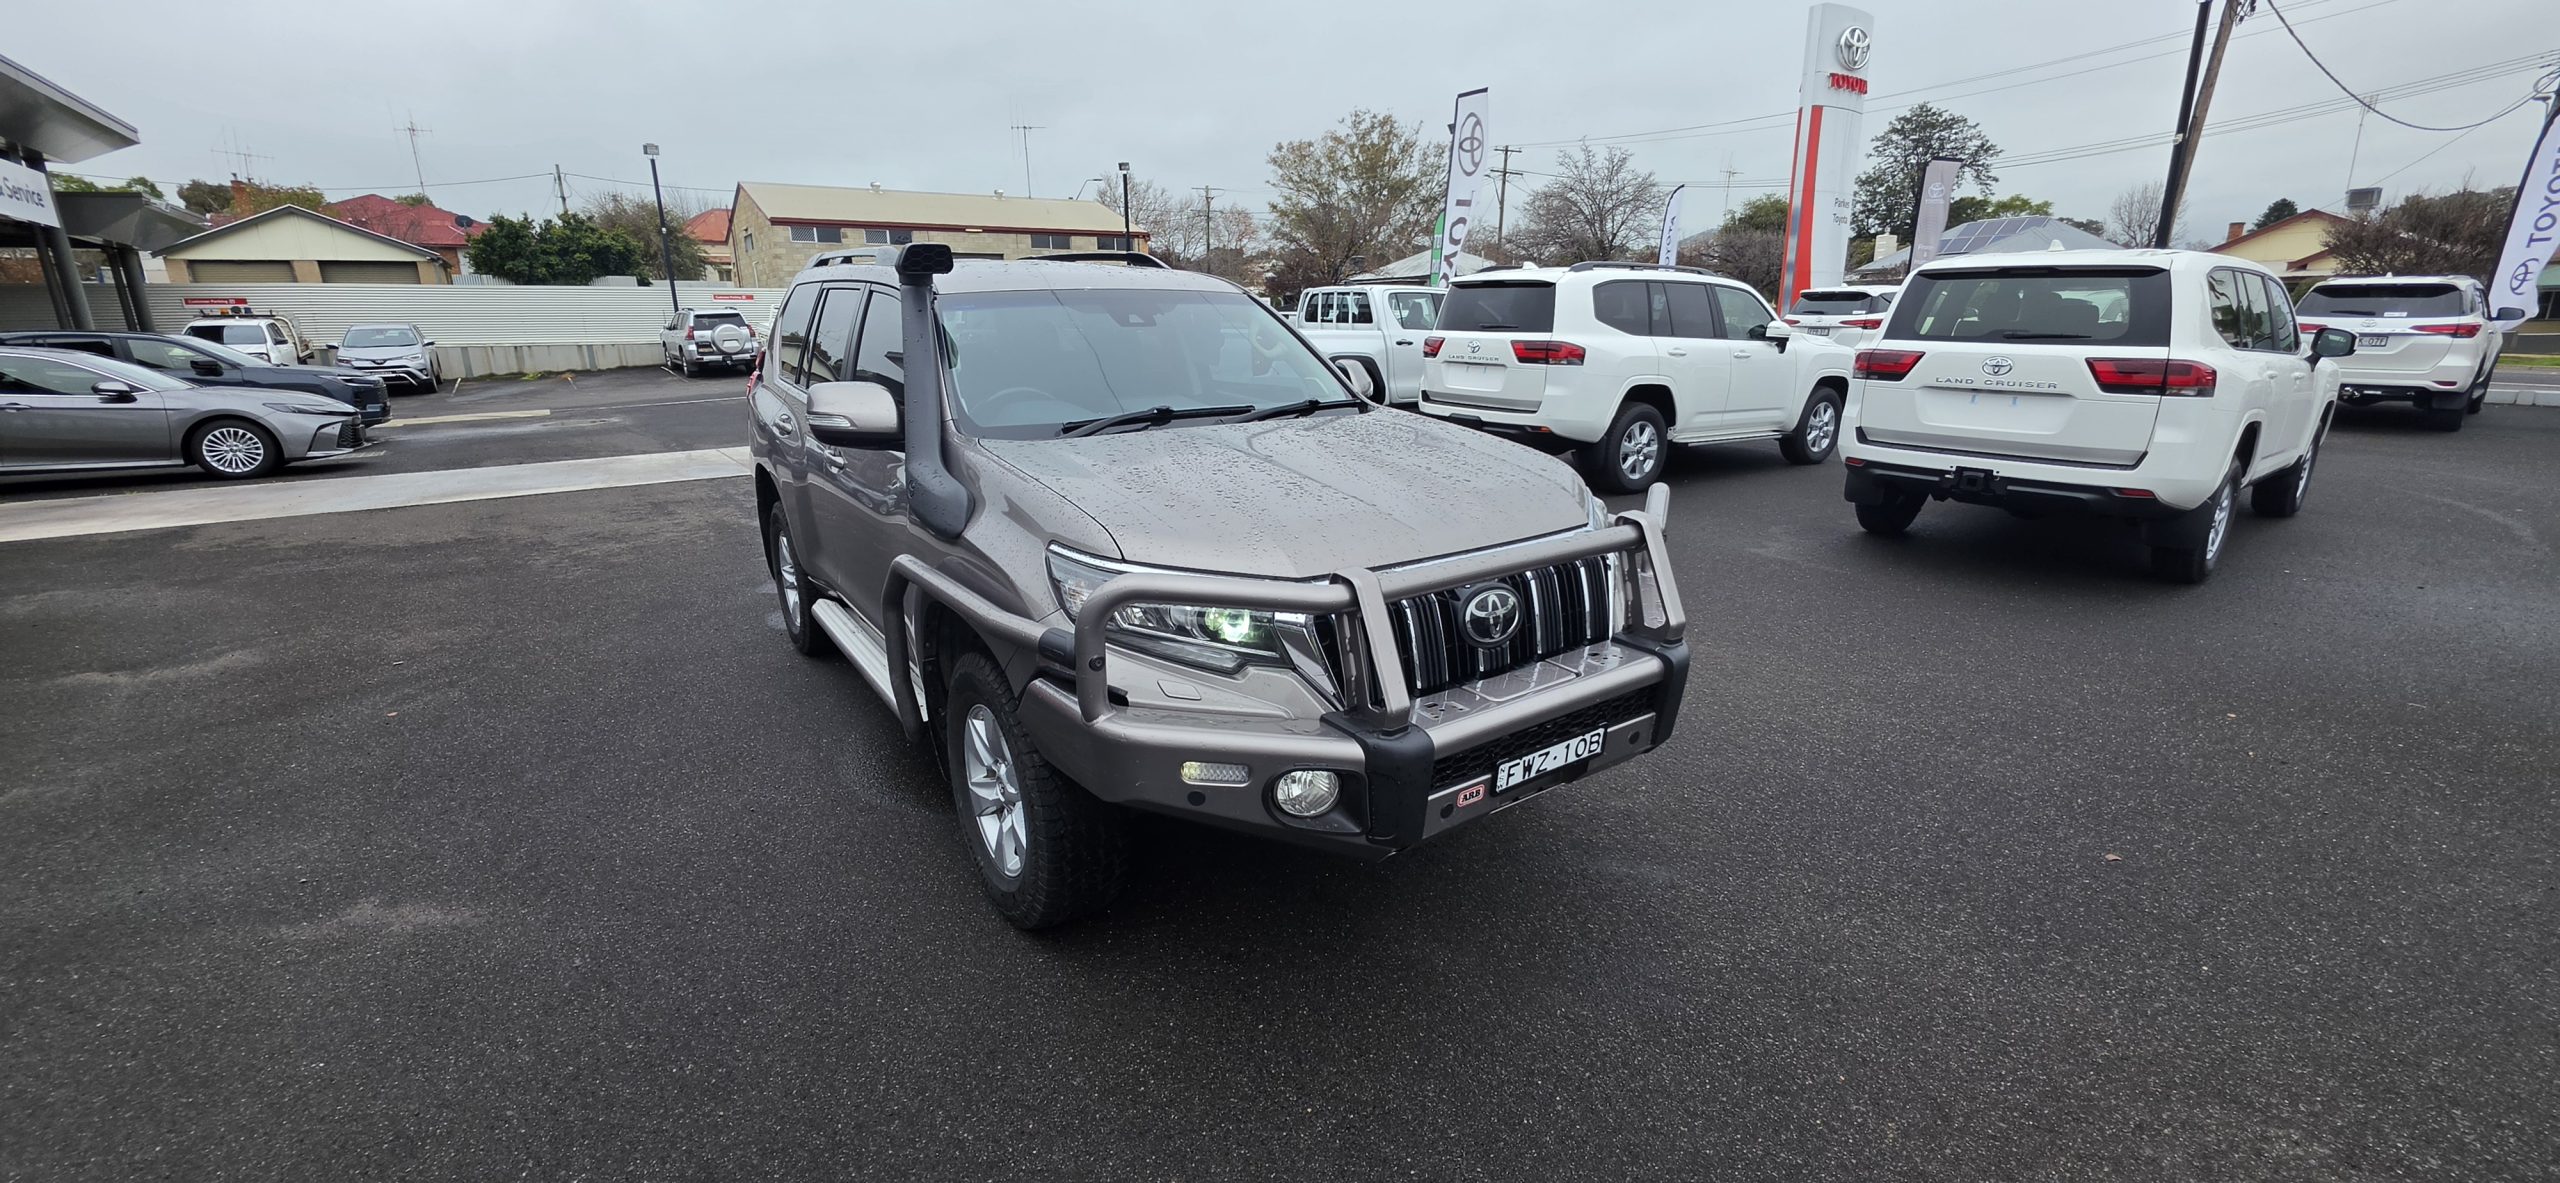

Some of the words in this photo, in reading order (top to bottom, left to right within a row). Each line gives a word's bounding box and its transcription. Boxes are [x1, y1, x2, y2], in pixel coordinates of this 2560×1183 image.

[1935, 377, 1975, 385] LAND
[1983, 379, 2059, 389] CRUISER
[1461, 787, 1482, 803] ARB
